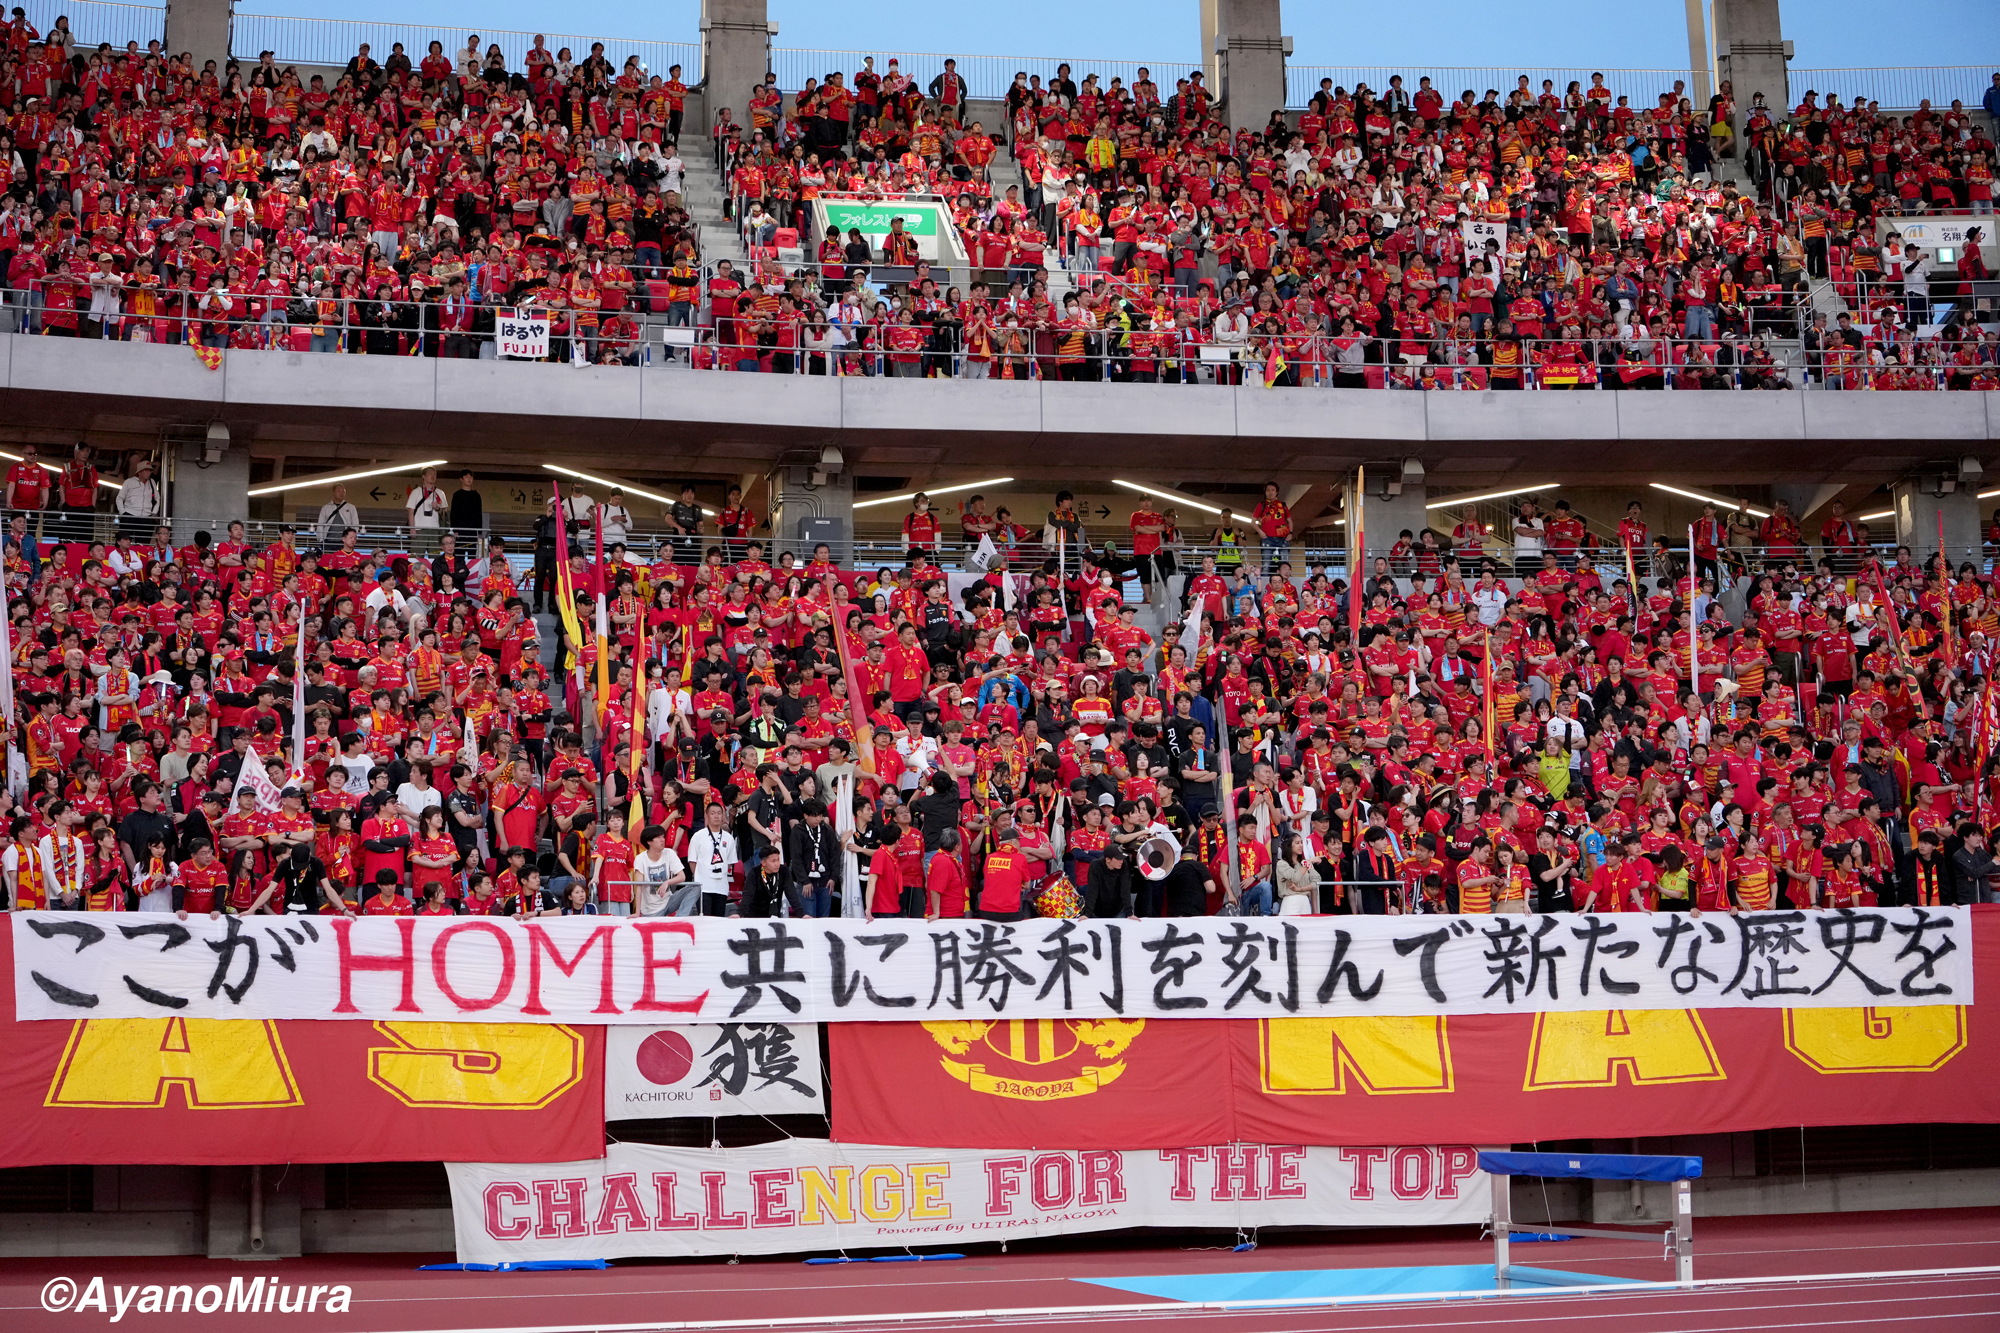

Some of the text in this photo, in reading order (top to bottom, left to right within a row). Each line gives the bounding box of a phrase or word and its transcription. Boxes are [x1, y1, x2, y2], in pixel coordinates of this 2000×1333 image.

[1473, 223, 1495, 235] さぁ
[501, 322, 545, 340] はるや
[503, 342, 543, 355] FUJII
[746, 777, 757, 789] 12
[993, 1079, 1075, 1098] NAGOYA
[624, 1091, 694, 1103] KACHITORU
[483, 1145, 1480, 1241] CHALLENGE FOR THE TOP
[875, 1206, 1118, 1236] Powered by ULTRAS NAGOYA
